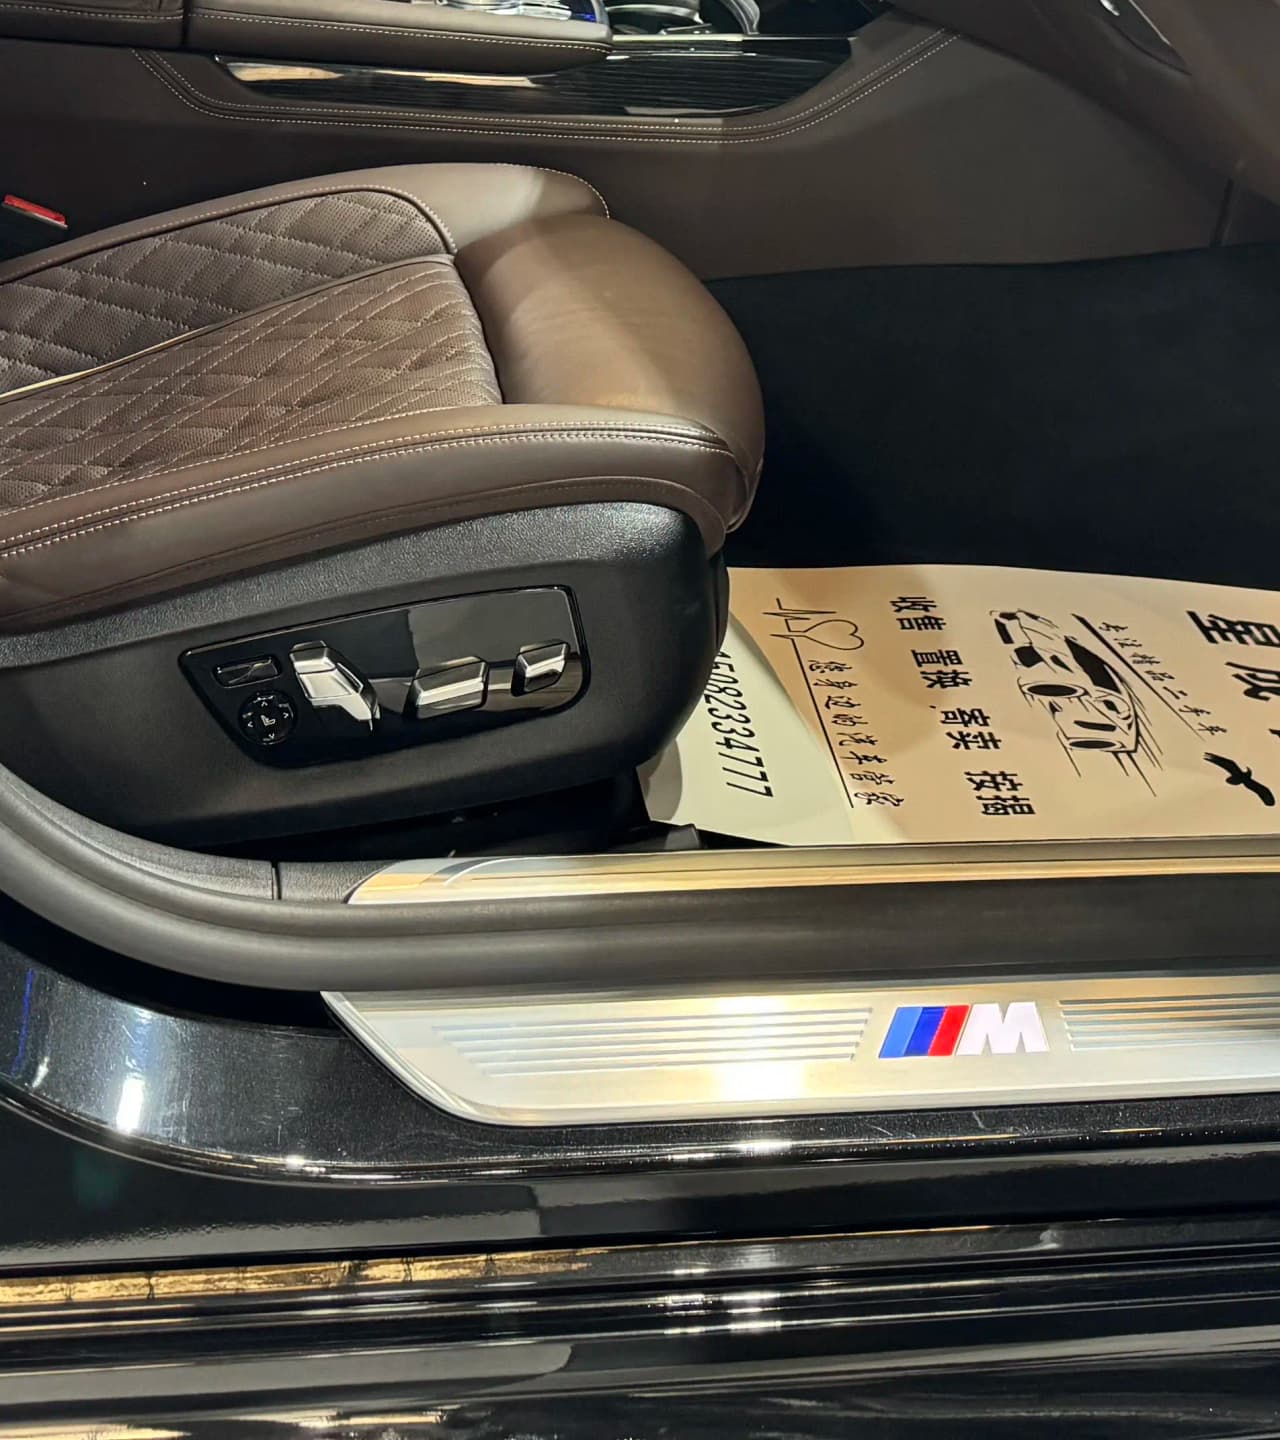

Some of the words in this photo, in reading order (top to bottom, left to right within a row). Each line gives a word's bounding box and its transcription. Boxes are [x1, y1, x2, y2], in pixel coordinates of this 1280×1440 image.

[890, 596, 947, 631] 收售
[911, 649, 972, 689] 置换
[940, 707, 1001, 750] 寄卖
[964, 771, 1036, 816] 按揭
[956, 1001, 1051, 1056] M
